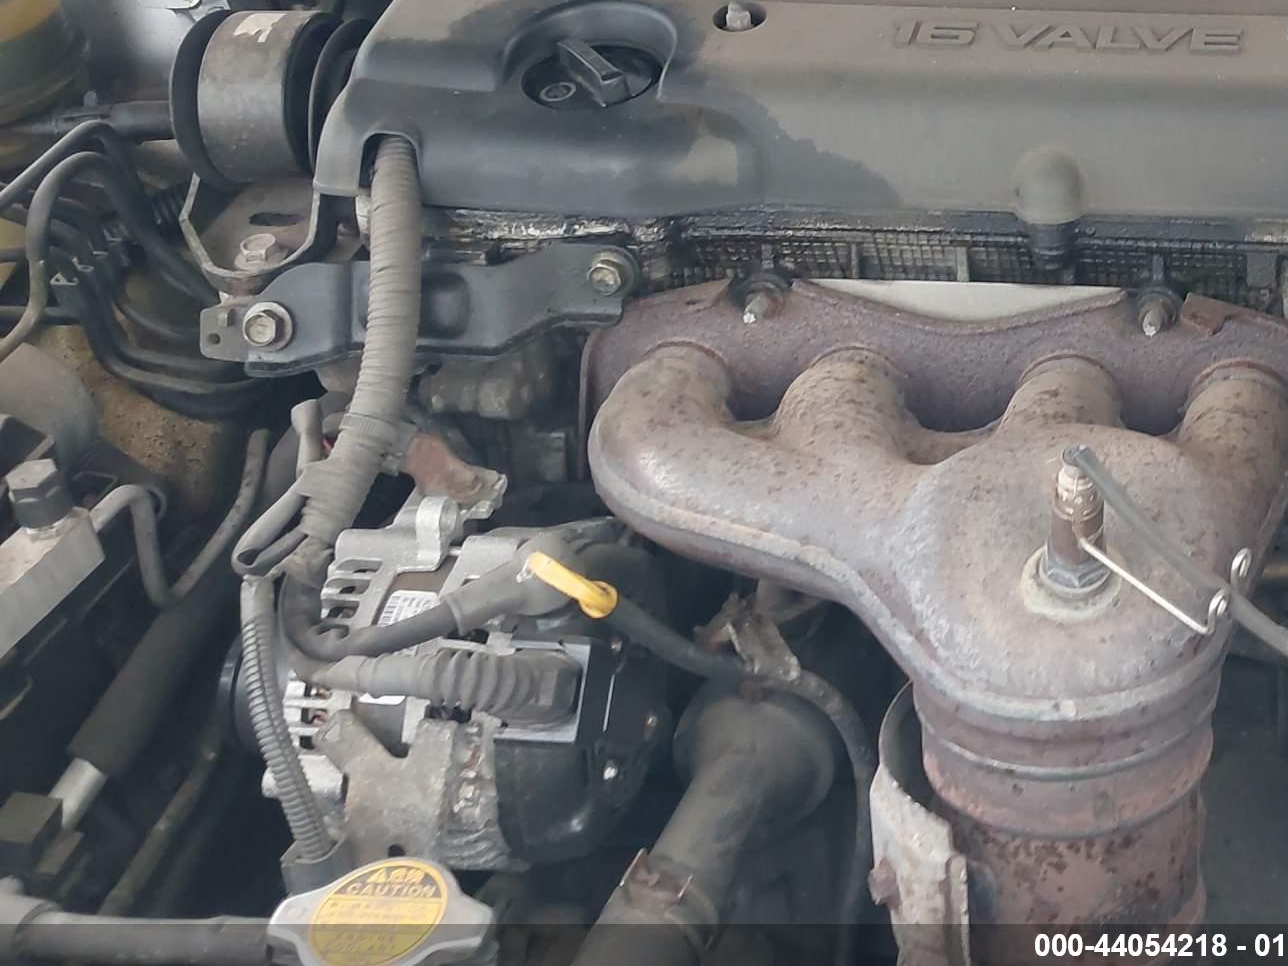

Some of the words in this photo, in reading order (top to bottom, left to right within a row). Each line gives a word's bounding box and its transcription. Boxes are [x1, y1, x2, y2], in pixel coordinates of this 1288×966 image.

[897, 19, 980, 50] 16
[992, 22, 1245, 54] VALVE
[346, 882, 437, 899] CAUTION
